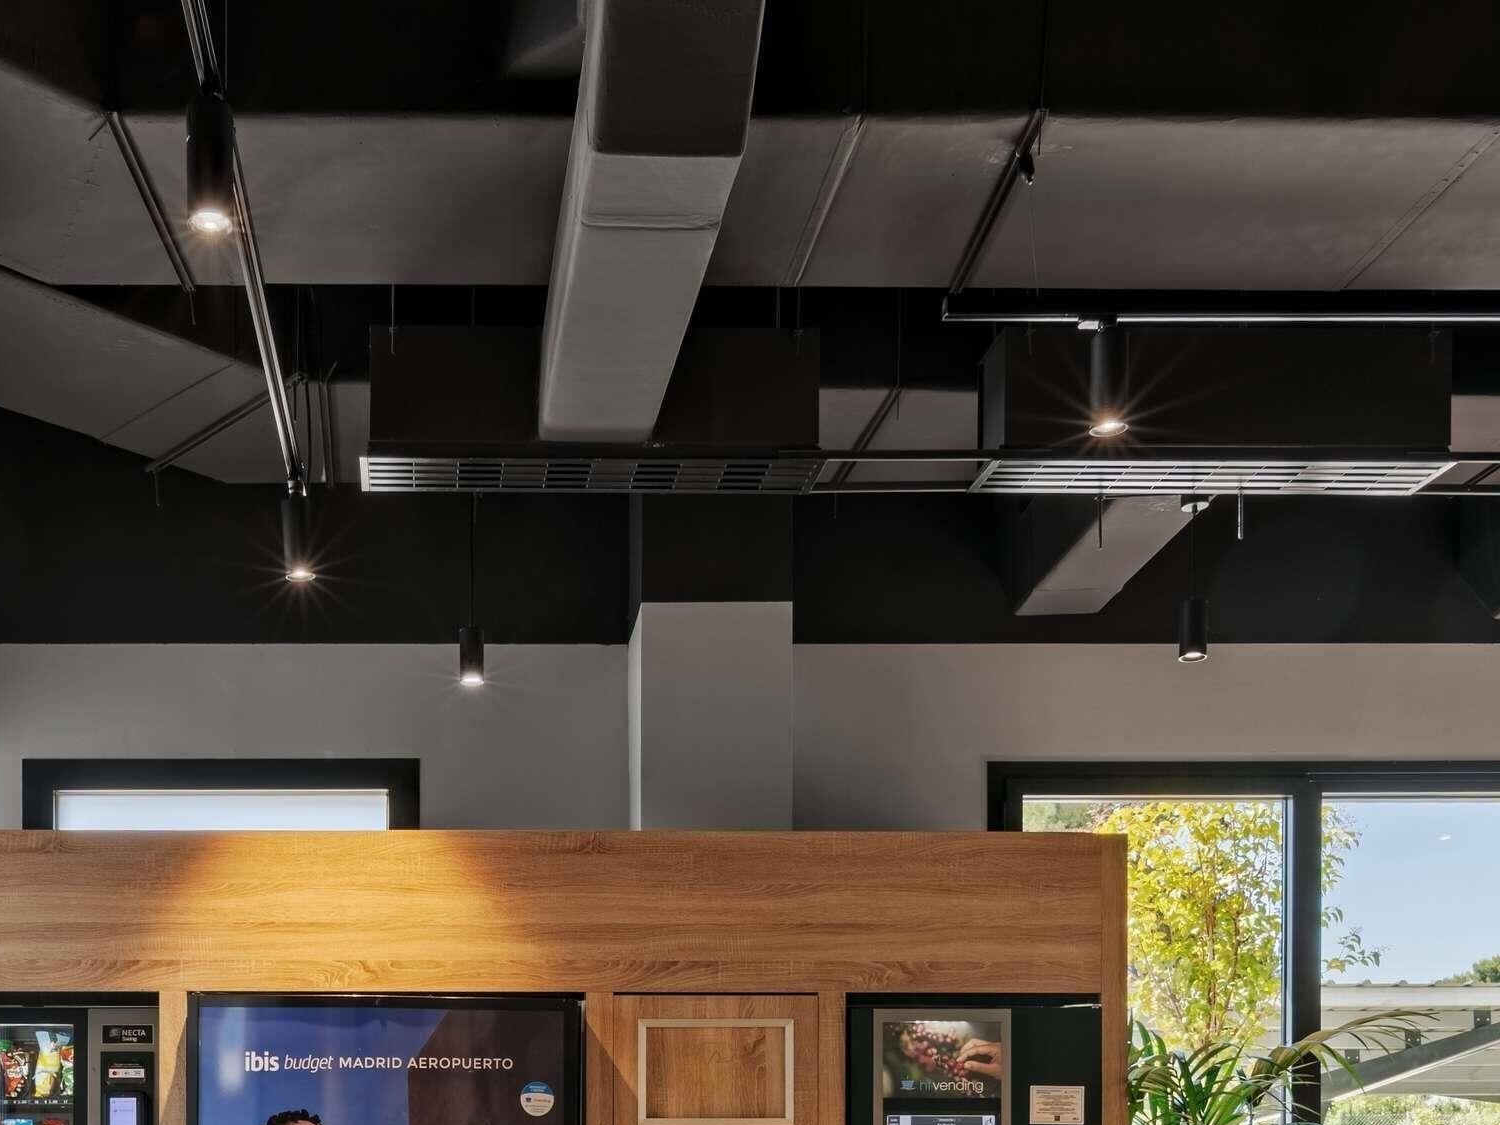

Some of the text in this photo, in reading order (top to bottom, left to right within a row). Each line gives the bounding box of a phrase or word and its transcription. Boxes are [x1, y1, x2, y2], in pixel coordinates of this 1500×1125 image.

[121, 1029, 146, 1037] NECTA
[244, 1051, 514, 1073] ibis budget MADRID AEROPUERTO
